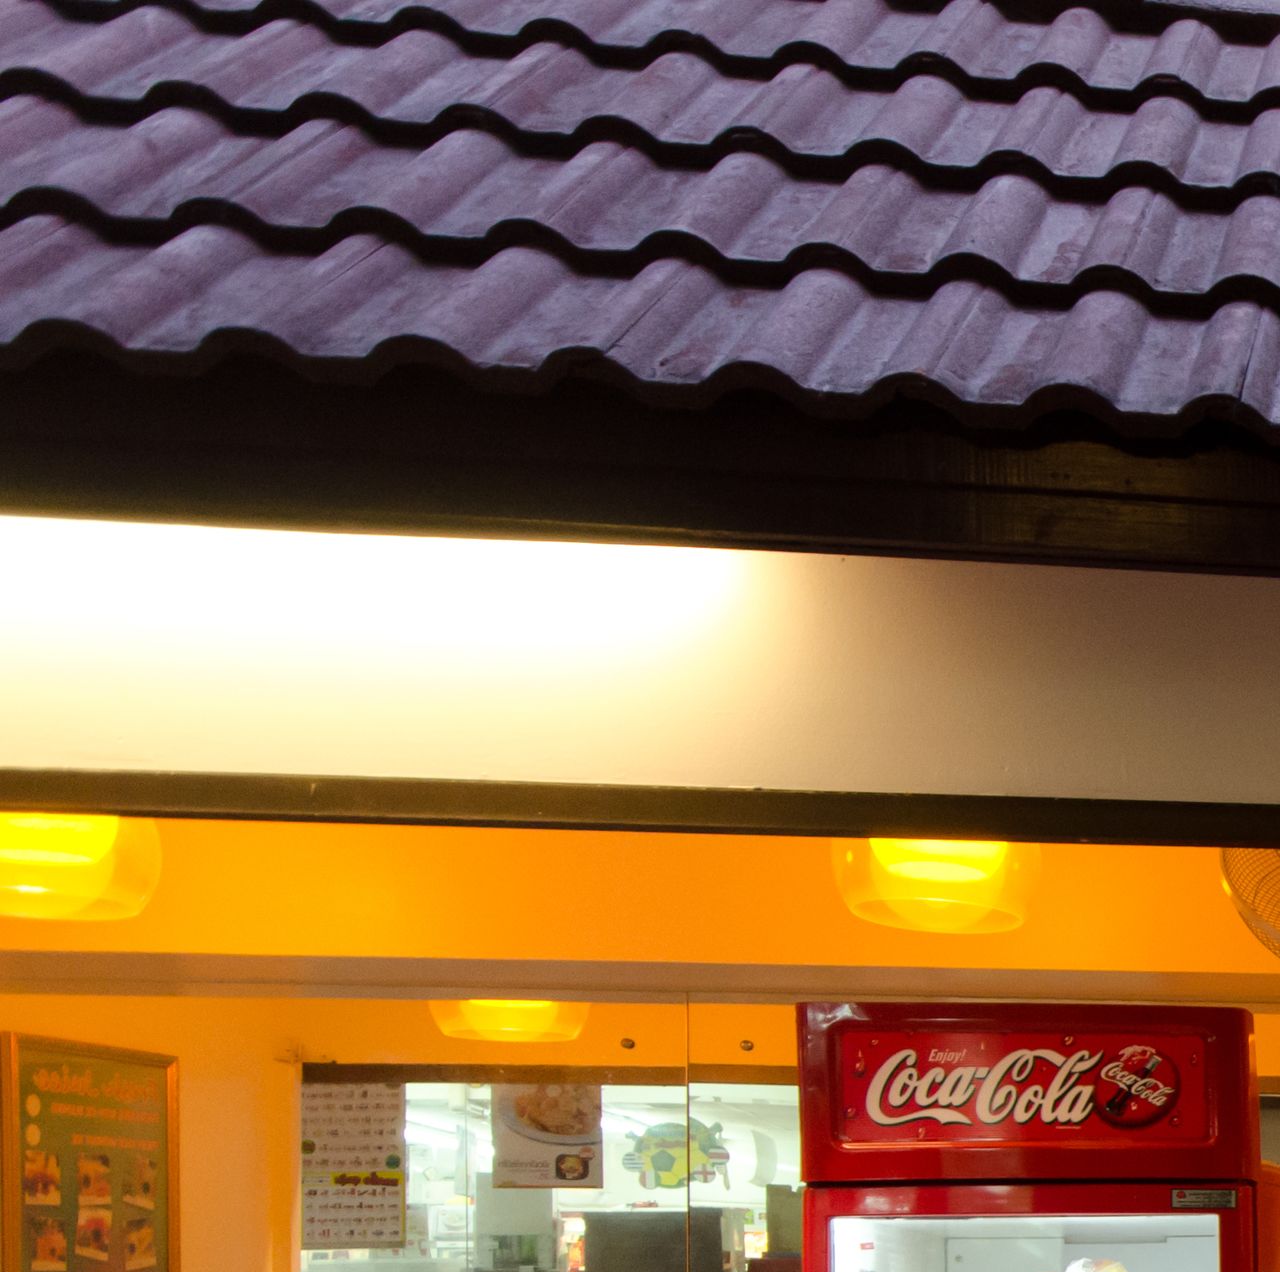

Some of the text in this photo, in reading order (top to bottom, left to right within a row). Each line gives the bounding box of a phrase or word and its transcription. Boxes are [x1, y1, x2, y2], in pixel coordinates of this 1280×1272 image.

[928, 1048, 966, 1063] Enjoy!
[865, 1048, 1104, 1126] Coca-Cola
[1100, 1061, 1176, 1107] Coca-Cola
